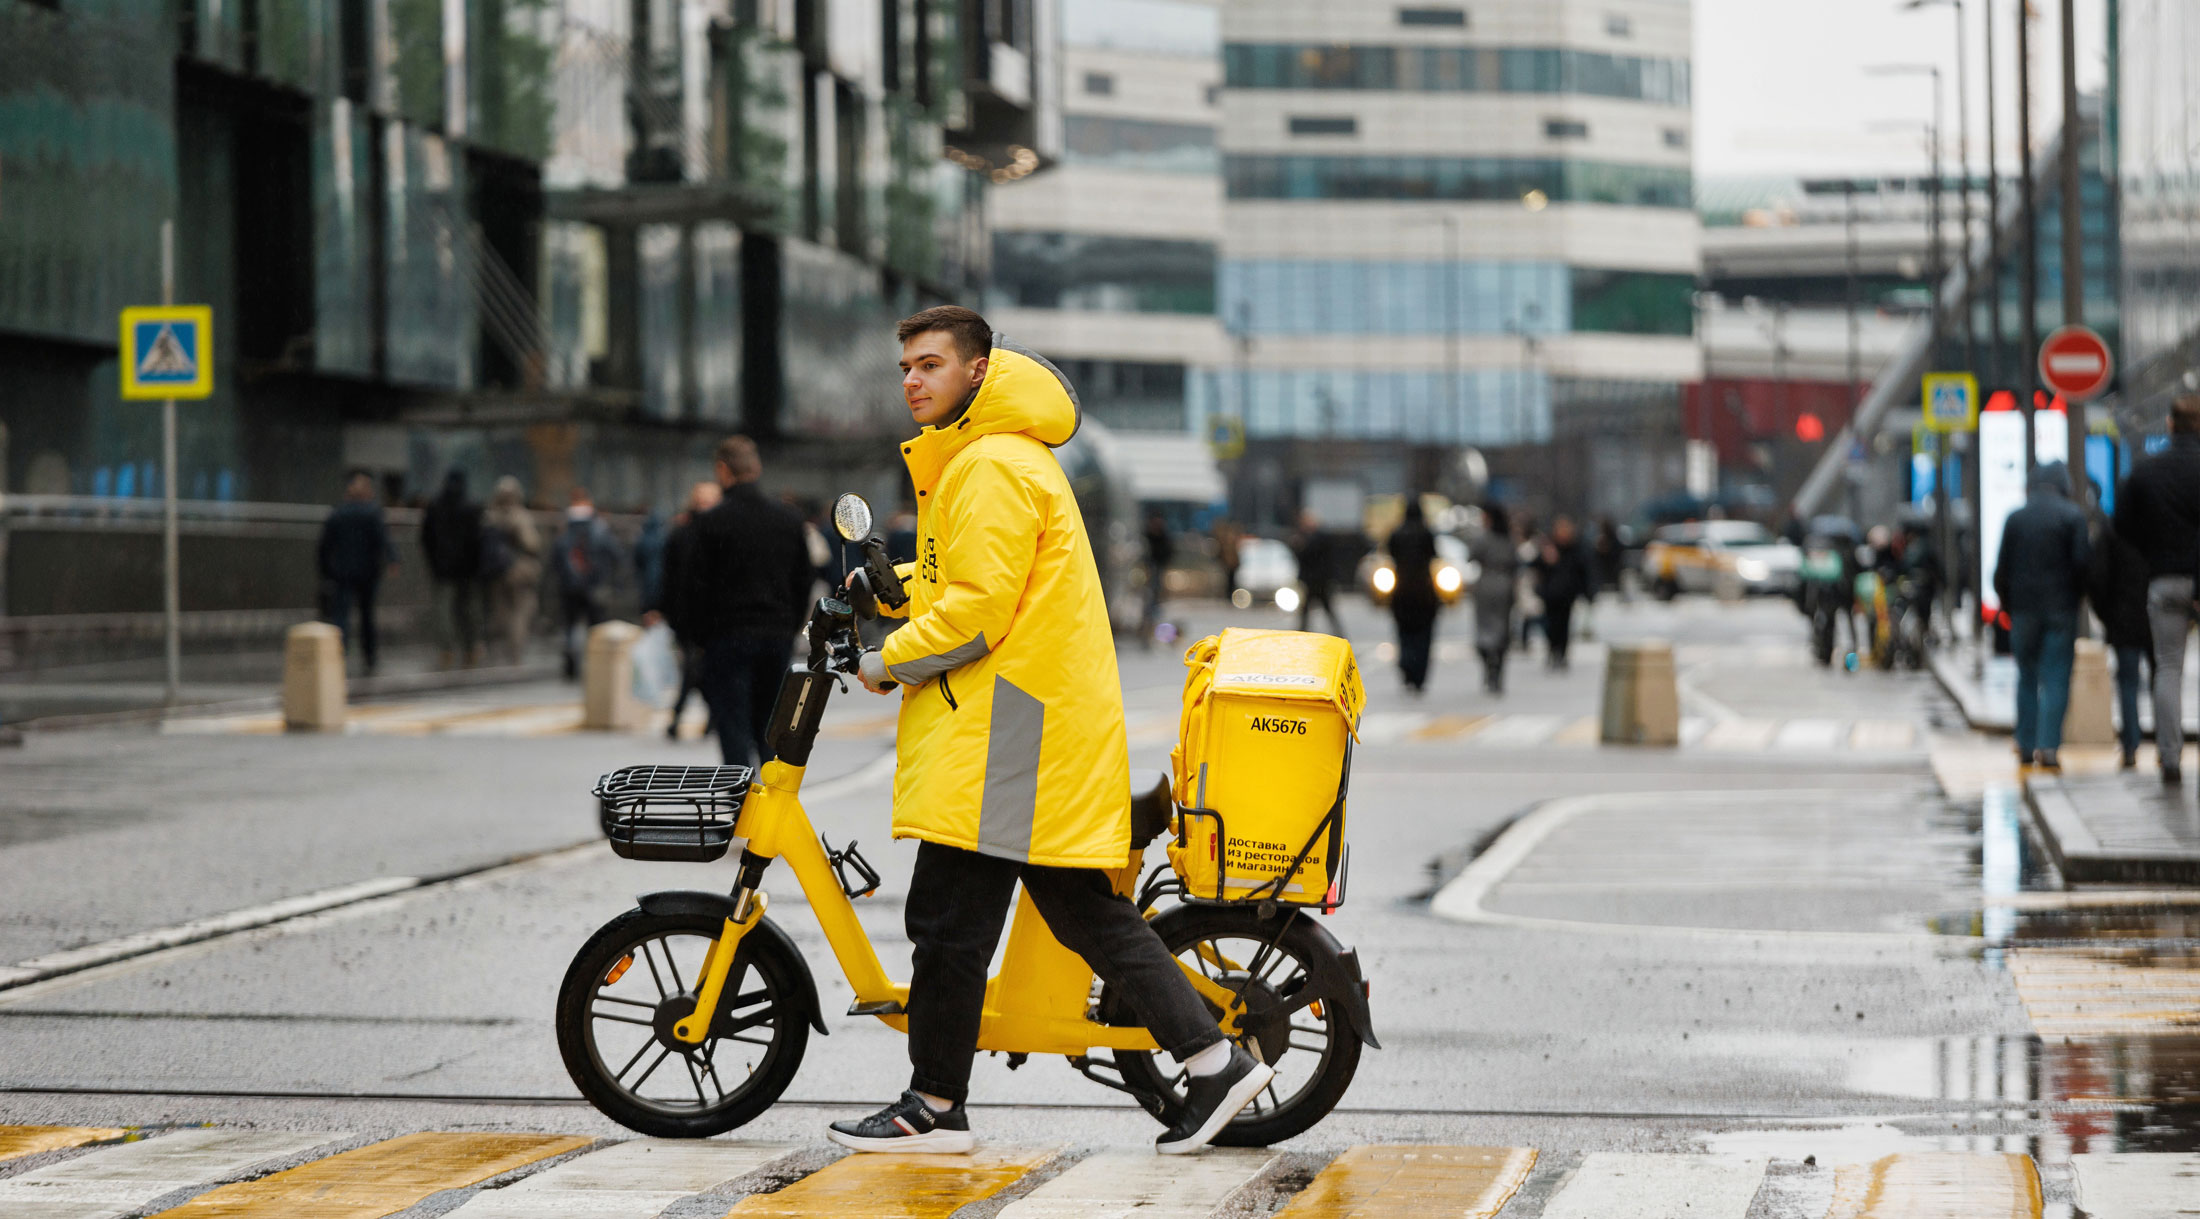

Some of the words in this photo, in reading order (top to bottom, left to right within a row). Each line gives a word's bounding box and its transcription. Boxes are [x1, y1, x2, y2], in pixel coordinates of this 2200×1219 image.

[1250, 717, 1307, 735] AK5676
[1228, 837, 1287, 851] доставка
[1227, 848, 1242, 858] из
[1244, 851, 1320, 864] рестораов
[1226, 860, 1234, 869] и
[1237, 862, 1304, 875] магазинв
[920, 1107, 935, 1125] USPA
